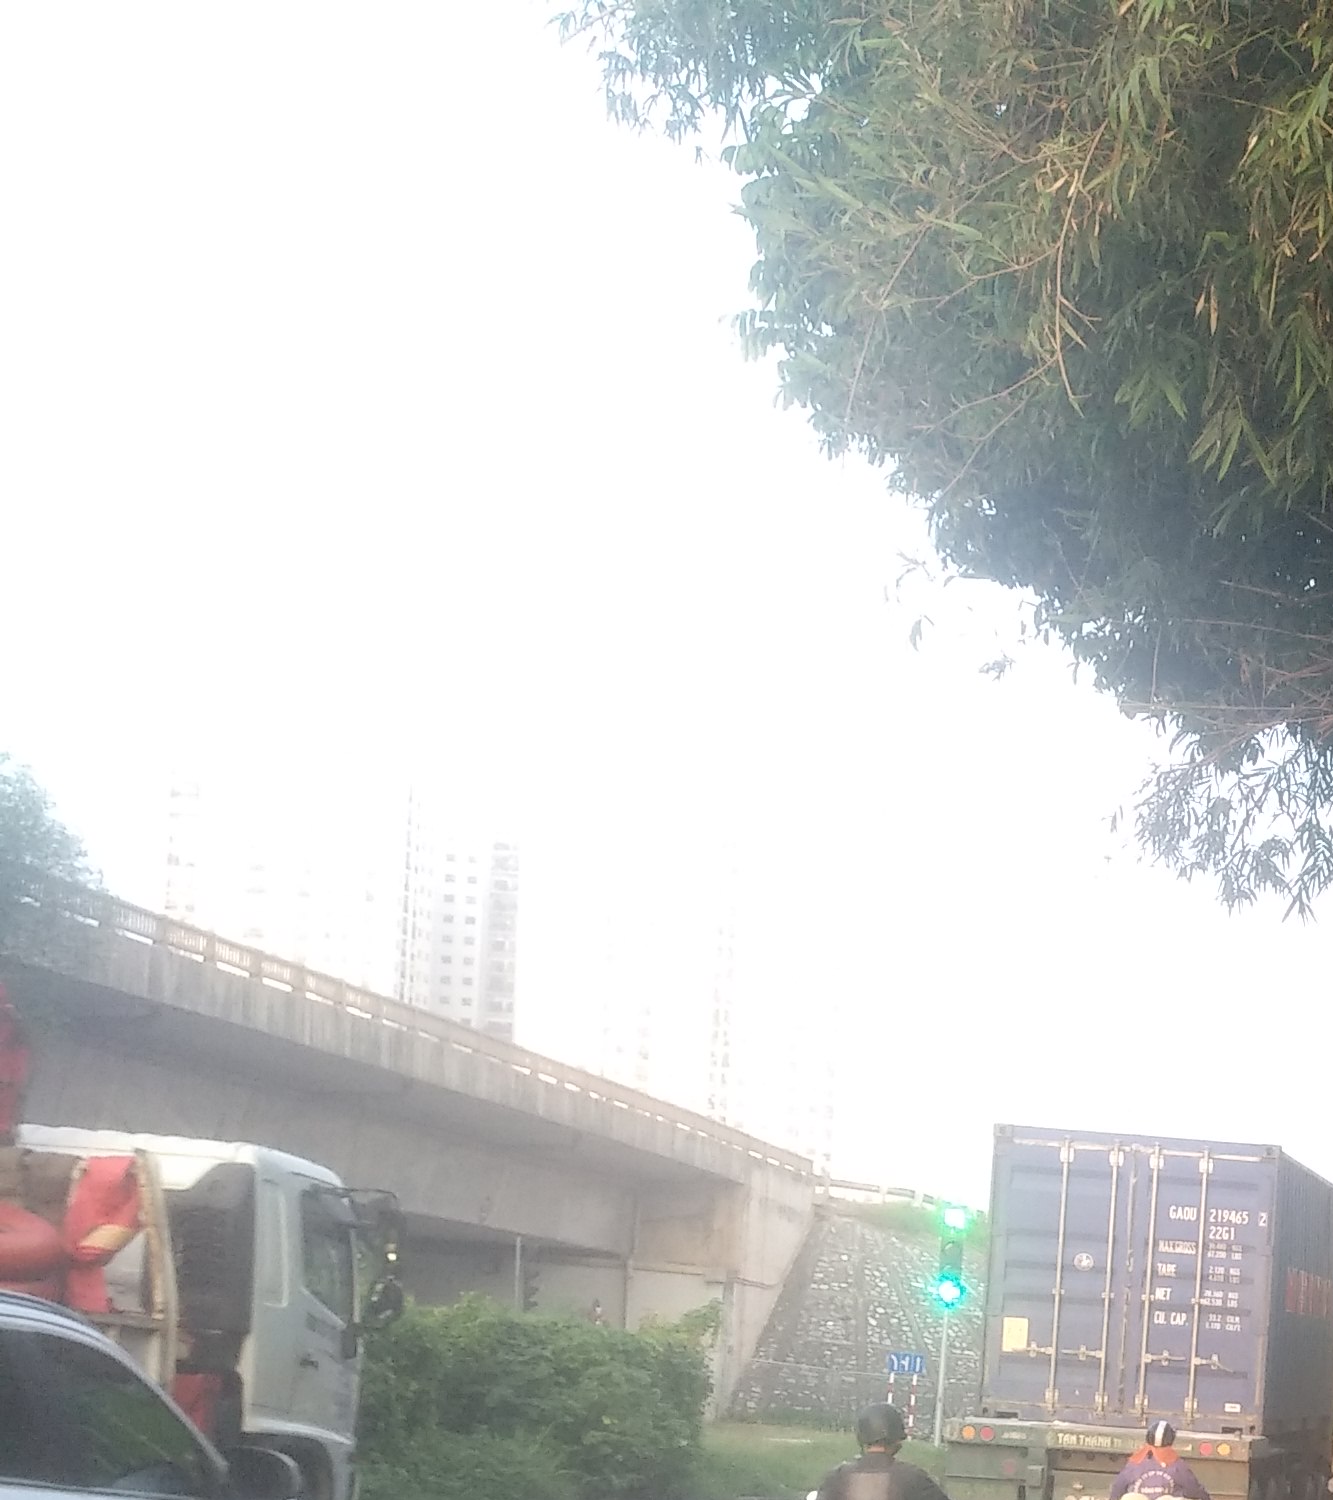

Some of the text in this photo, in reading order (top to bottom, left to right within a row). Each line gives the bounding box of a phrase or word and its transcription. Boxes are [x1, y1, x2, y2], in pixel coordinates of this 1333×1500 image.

[1169, 1205, 1267, 1226] GAOU 219465 2
[1208, 1226, 1235, 1240] 22G1
[1155, 1287, 1172, 1301] NET
